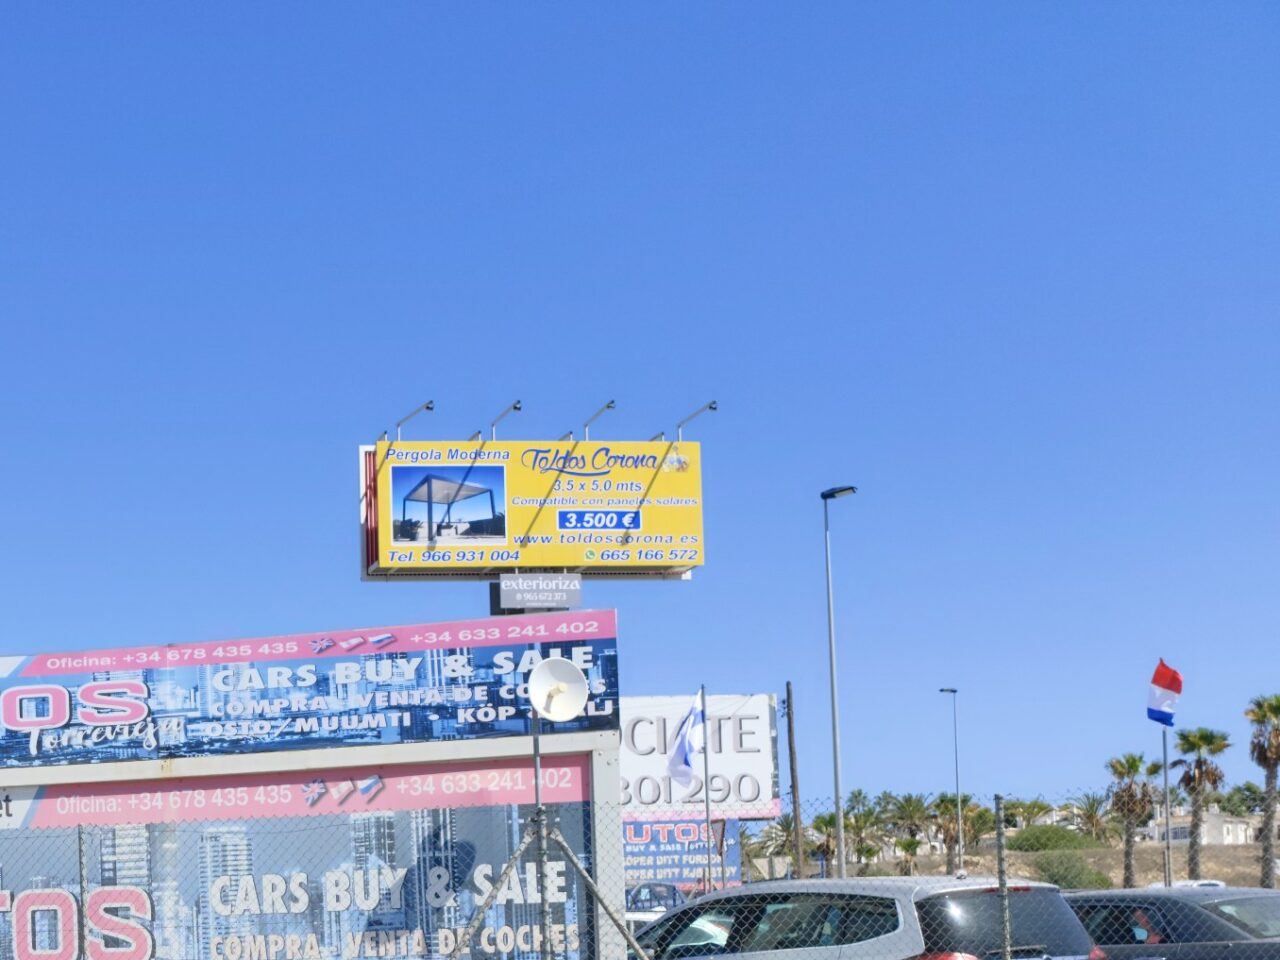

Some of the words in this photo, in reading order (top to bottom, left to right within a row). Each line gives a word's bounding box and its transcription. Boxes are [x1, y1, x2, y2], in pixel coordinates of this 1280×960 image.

[447, 448, 510, 461] Moderna
[591, 446, 658, 471] Corona
[578, 481, 587, 491] x
[511, 496, 579, 507] Compatible
[607, 496, 653, 507] paneles
[655, 496, 698, 506] solares
[564, 512, 618, 528] 3.500
[621, 512, 636, 528] €
[388, 550, 417, 562] Tel.
[421, 550, 452, 562] 966
[456, 550, 486, 562] 931
[490, 550, 521, 562] 004
[600, 549, 631, 561] 665
[636, 549, 664, 561] 166
[668, 549, 699, 561] 572
[500, 576, 581, 590] exterioriza
[410, 631, 452, 645] +34
[458, 627, 501, 641] 633
[507, 624, 550, 637] 241
[555, 620, 600, 634] 402
[46, 655, 117, 671] Oficina:
[122, 651, 162, 665] +34
[166, 648, 207, 661] 678
[212, 644, 253, 658] 435
[258, 641, 300, 656] 435
[212, 664, 319, 692] CARS
[334, 657, 424, 685] BUY
[443, 653, 474, 678] &
[210, 695, 329, 717] COMPRA
[358, 687, 444, 708] VENTA
[454, 684, 489, 701] DE
[457, 703, 516, 723] KÖP
[396, 776, 436, 797] +34
[440, 773, 482, 794] 633
[487, 770, 526, 792] 241
[680, 772, 762, 804] 290
[55, 795, 122, 815] Oficina:
[128, 791, 163, 811] +34
[169, 789, 207, 809] 678
[211, 786, 249, 807] 435
[253, 784, 293, 804] 435
[622, 822, 717, 844] UTOS
[211, 872, 310, 916] CARS
[325, 867, 408, 912] BUY
[425, 865, 458, 908] &
[473, 861, 568, 907] SALE
[346, 927, 428, 960] VENTA
[438, 926, 472, 955] DE
[480, 923, 581, 955] COCHES
